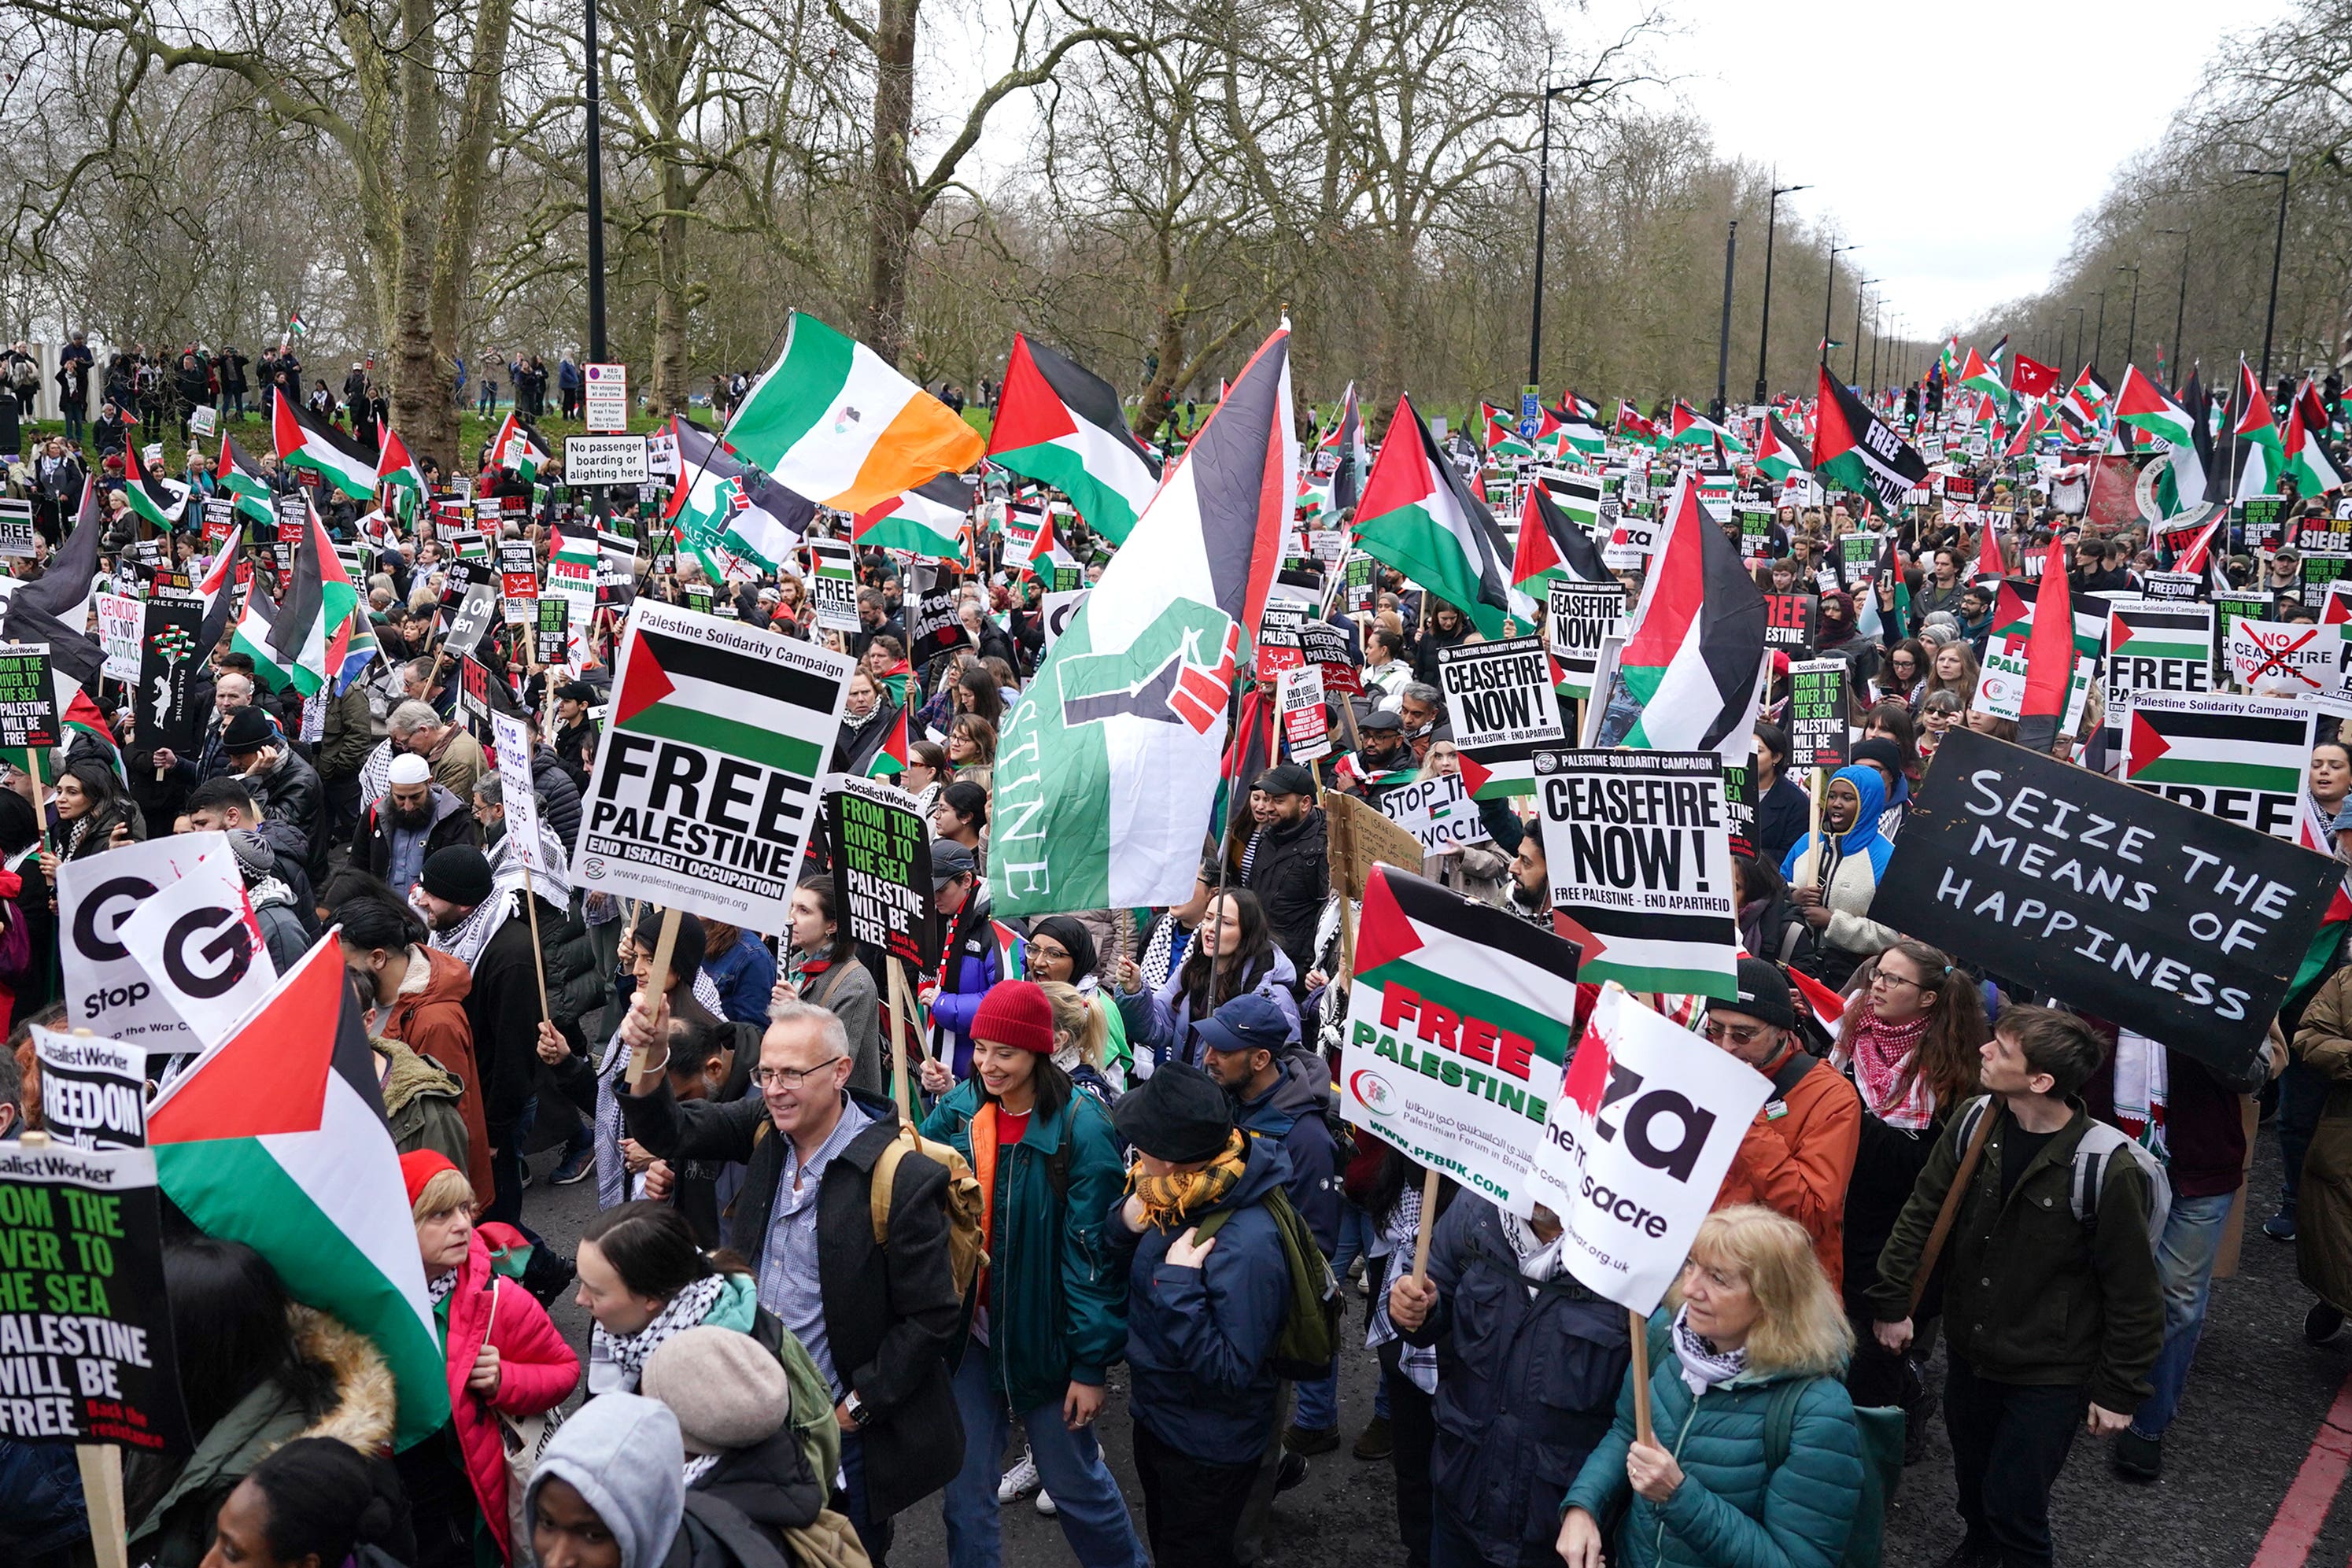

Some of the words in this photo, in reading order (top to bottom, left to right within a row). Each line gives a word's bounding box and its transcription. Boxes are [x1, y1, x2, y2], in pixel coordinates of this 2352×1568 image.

[570, 442, 585, 452] No
[589, 442, 642, 454] passenger
[1864, 418, 1903, 463] FREE
[576, 456, 623, 467] boarding
[570, 469, 618, 481] alighting
[621, 467, 644, 477] here
[1947, 478, 1974, 493] FREE
[1947, 492, 1974, 500] PALESTINE
[207, 504, 231, 513] FREEDOM
[2303, 518, 2327, 531] END
[2330, 520, 2352, 533] THE
[1742, 534, 1770, 543] PALESTINE
[2299, 530, 2351, 551] SIEGE
[502, 548, 530, 559] FREEDOM
[2331, 559, 2346, 568] THE
[503, 563, 534, 573] PALESTINE
[556, 559, 590, 580] FREE
[172, 575, 190, 587] GAZA
[548, 577, 594, 592] PALESTINE
[814, 577, 855, 603] FREE
[2147, 582, 2195, 596] FREEDOM
[100, 598, 138, 622] GENOCIDE
[177, 600, 203, 610] FREE
[817, 600, 857, 614] PALESTINE
[1550, 594, 1623, 618] CEASEFIRE
[2112, 603, 2142, 611] Palestine
[2143, 604, 2175, 613] Solidarity
[2176, 605, 2210, 614] Campaign
[2220, 602, 2243, 614] FROM
[2245, 602, 2263, 614] THE
[1265, 611, 1302, 625] FREEDOM
[109, 619, 119, 636] IS
[120, 619, 135, 639] NOT
[2262, 632, 2291, 647] NO
[107, 638, 141, 661] JUSTICE
[639, 610, 703, 639] Palestine
[706, 628, 773, 660] Solidarity
[776, 646, 844, 678] Campaign
[1303, 633, 1347, 651] FREEDOM
[1452, 644, 1482, 659] PALESTINE
[1482, 641, 1509, 656] SOLIDARITY
[1509, 638, 1539, 651] CAMPAIGN
[1305, 651, 1353, 668] PALESTINE
[2234, 642, 2333, 664] CEASEFIRE
[24, 657, 43, 671] THE
[1444, 654, 1549, 695] CEASEFIRE
[2110, 656, 2208, 692] FREE
[26, 672, 39, 686] TO
[1794, 673, 1819, 688] FROM
[1823, 673, 1841, 688] THE
[18, 687, 38, 701] SEA
[175, 669, 186, 722] PALESTINE
[1286, 696, 1305, 710] STATE
[1287, 688, 1301, 699] END
[1794, 689, 1819, 703] RIVER
[1822, 688, 1837, 703] TO
[1, 701, 51, 716] PALESTINE
[1793, 704, 1811, 718] THE
[1812, 703, 1833, 718] SEA
[2133, 696, 2188, 710] Palestine
[2189, 699, 2244, 714] Solidarity
[2249, 703, 2309, 718] Campaign
[2, 717, 25, 731] WILL
[27, 717, 40, 730] BE
[1793, 719, 1844, 734] PALESTINE
[4, 732, 28, 746] FREE
[1457, 736, 1472, 747] FREE
[1472, 732, 1506, 745] PALESTINE
[1511, 730, 1524, 740] END
[1525, 726, 1562, 739] APARTHEID
[1793, 734, 1813, 749] WILL
[1815, 734, 1830, 748] BE
[1562, 754, 1608, 768] PALESTINE
[1609, 756, 1661, 769] SOLIDARITY
[1661, 757, 1713, 770] CAMPAIGN
[1793, 750, 1813, 764] FREE
[598, 731, 814, 849] FREE
[1383, 781, 1436, 819] STOP
[1545, 777, 1720, 828] CEASEFIRE
[841, 795, 885, 831] FROM
[891, 810, 921, 842] THE
[589, 800, 796, 880] PALESTINE
[844, 820, 888, 856] RIVER
[892, 836, 913, 863] TO
[1965, 769, 2155, 865] SEIZE
[2181, 845, 2297, 920] THE
[587, 839, 622, 859] END
[623, 845, 685, 877] ISRAELI
[688, 859, 784, 900] OCCUPATION
[844, 843, 876, 875] THE
[878, 856, 908, 887] SEA
[613, 867, 748, 912] www.palestinecampaign.org
[847, 868, 925, 920] PALESTINE
[1555, 887, 1580, 901] FREE
[1583, 890, 1634, 906] PALESTINE
[1645, 895, 1667, 908] END
[1669, 895, 1730, 912] APARTHEID
[1970, 825, 2158, 913] MEANS
[2188, 912, 2267, 956] OF
[847, 891, 886, 926] WILL
[888, 909, 910, 935] BE
[850, 915, 887, 950] FREE
[163, 906, 252, 999] G
[1937, 867, 2251, 1021] HAPPINESS
[84, 981, 150, 1019] Stop
[150, 1023, 174, 1032] War
[1380, 980, 1536, 1082] FREE
[1352, 1019, 1548, 1125] PALESTINE
[42, 1070, 142, 1137] FREEDOM
[1403, 1112, 1457, 1140] Palestinian
[1458, 1134, 1490, 1154] Forum
[1491, 1148, 1500, 1159] in
[1501, 1153, 1528, 1175] Britai
[1368, 1119, 1509, 1201] www.PFBUK.COM
[61, 1189, 125, 1238] THE
[71, 1232, 114, 1278] TO
[45, 1274, 111, 1318] SEA
[76, 1359, 122, 1400] BE
[0, 1397, 79, 1437] FREE
